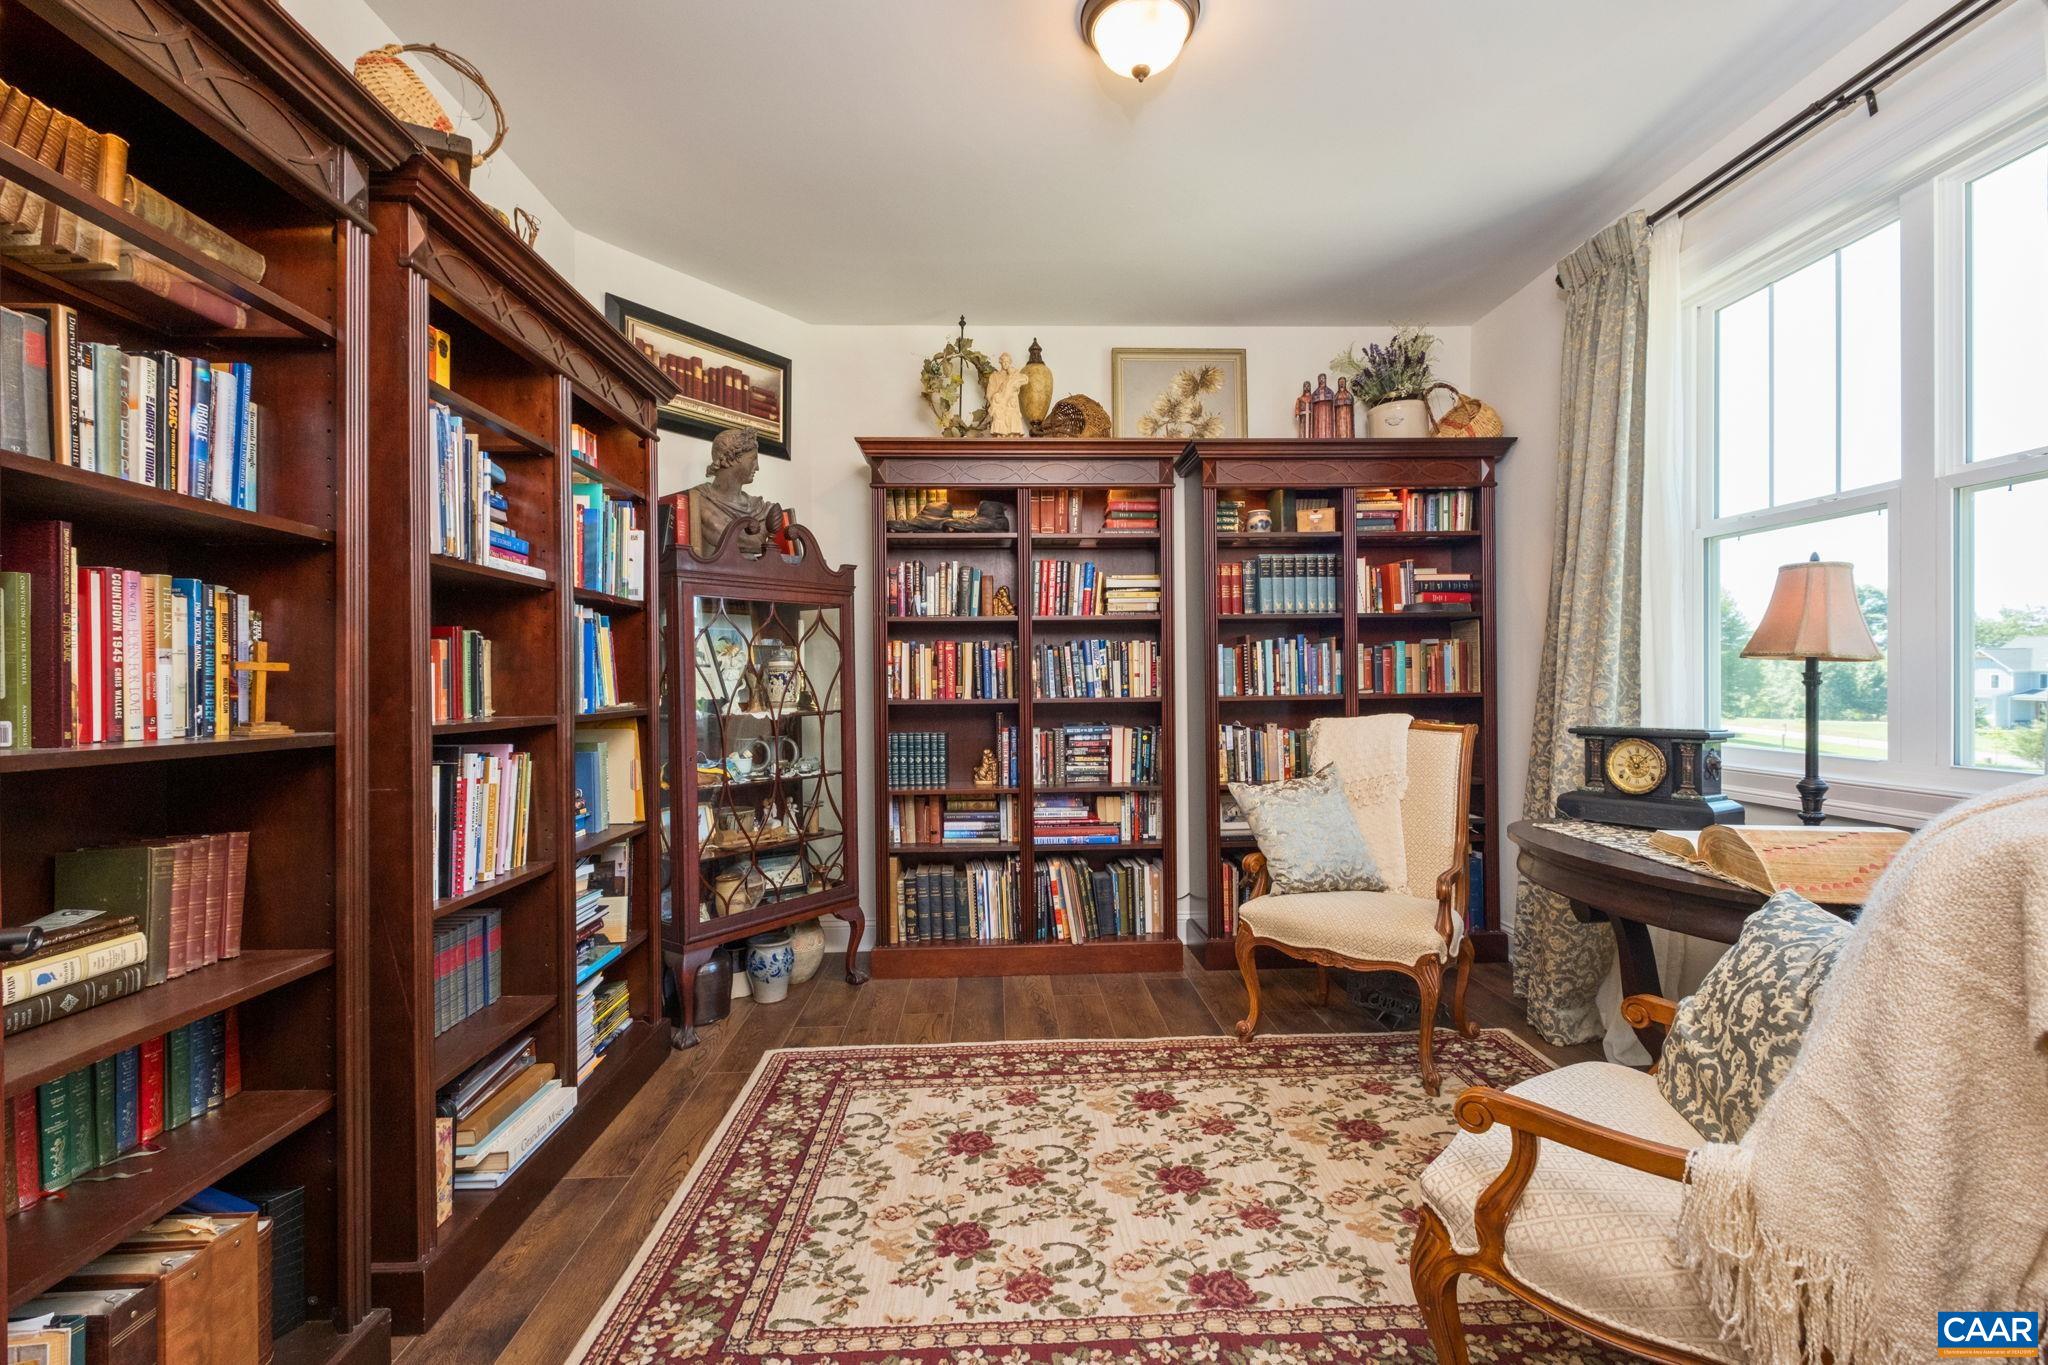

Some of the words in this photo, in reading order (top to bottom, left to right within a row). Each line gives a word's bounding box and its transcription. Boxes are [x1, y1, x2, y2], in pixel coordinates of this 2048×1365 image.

[69, 316, 78, 365] Darwin's
[71, 370, 79, 400] Black
[168, 386, 179, 430] MAGIC
[197, 402, 209, 443] ORACLE
[248, 443, 256, 469] Triangle
[112, 573, 123, 632] COUNTDOWN
[163, 586, 172, 609] THE
[20, 620, 27, 629] OF
[163, 614, 173, 640] LINK
[205, 609, 214, 645] ESCAPE
[62, 630, 71, 663] TREASURE
[112, 635, 123, 662] 1945
[194, 643, 202, 672] MANUAL
[20, 654, 28, 686] TRAVELER
[129, 663, 140, 684] FOR
[205, 648, 215, 676] FROM
[114, 667, 122, 687] CHRIS
[205, 679, 215, 696] THE
[114, 690, 123, 719] WALLACE
[129, 688, 141, 715] LOVE
[205, 698, 214, 722] DEEP
